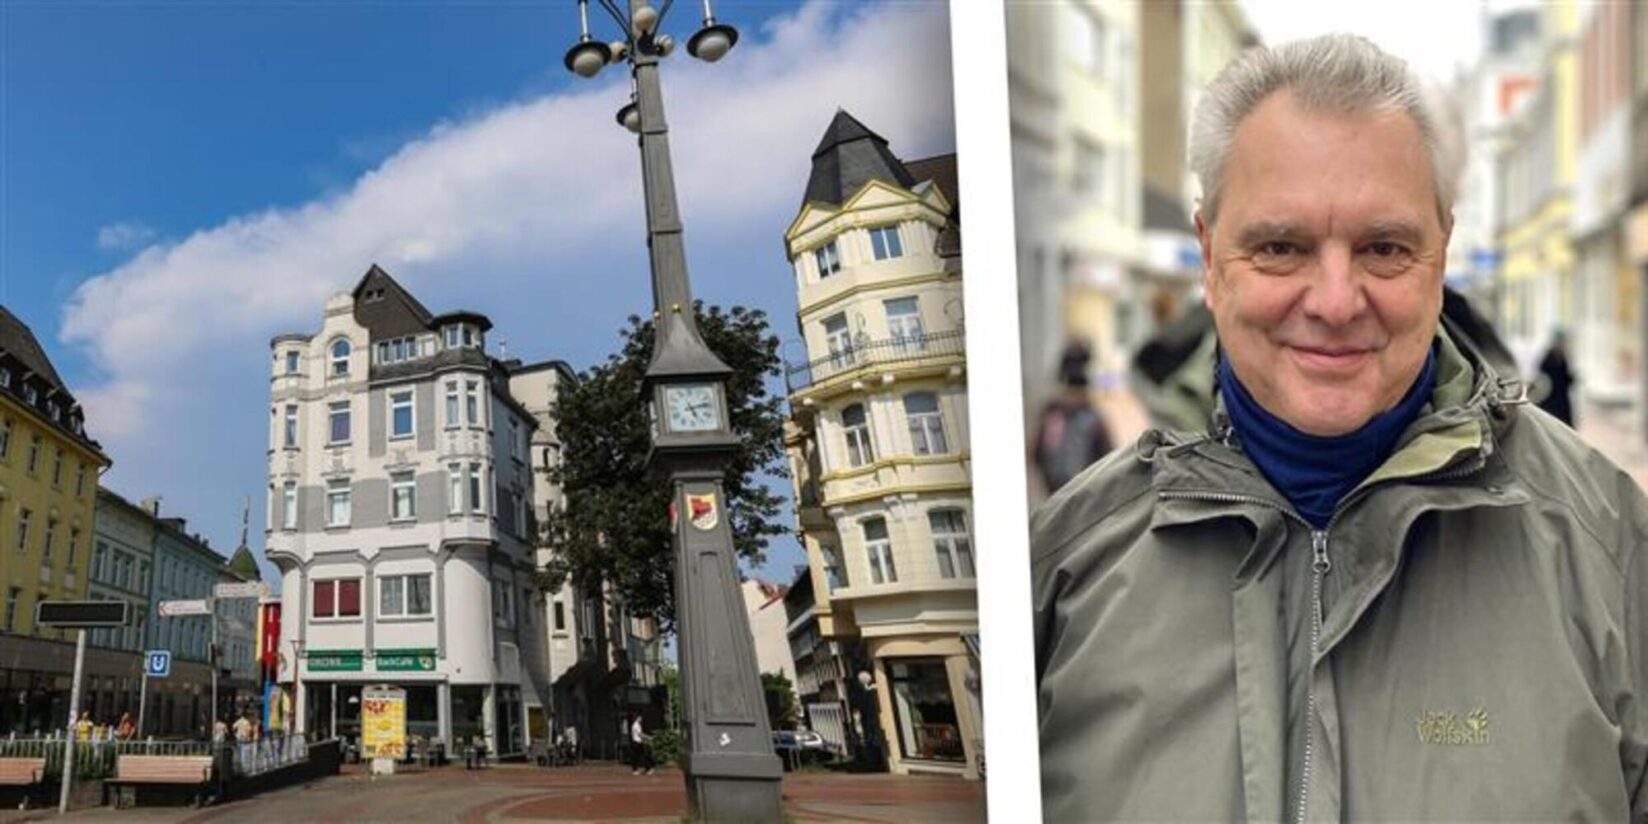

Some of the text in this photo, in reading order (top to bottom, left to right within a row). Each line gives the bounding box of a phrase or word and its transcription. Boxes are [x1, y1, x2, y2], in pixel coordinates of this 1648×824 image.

[152, 655, 165, 671] U
[1416, 710, 1456, 725] Jack
[1416, 723, 1490, 745] Wolfskin
